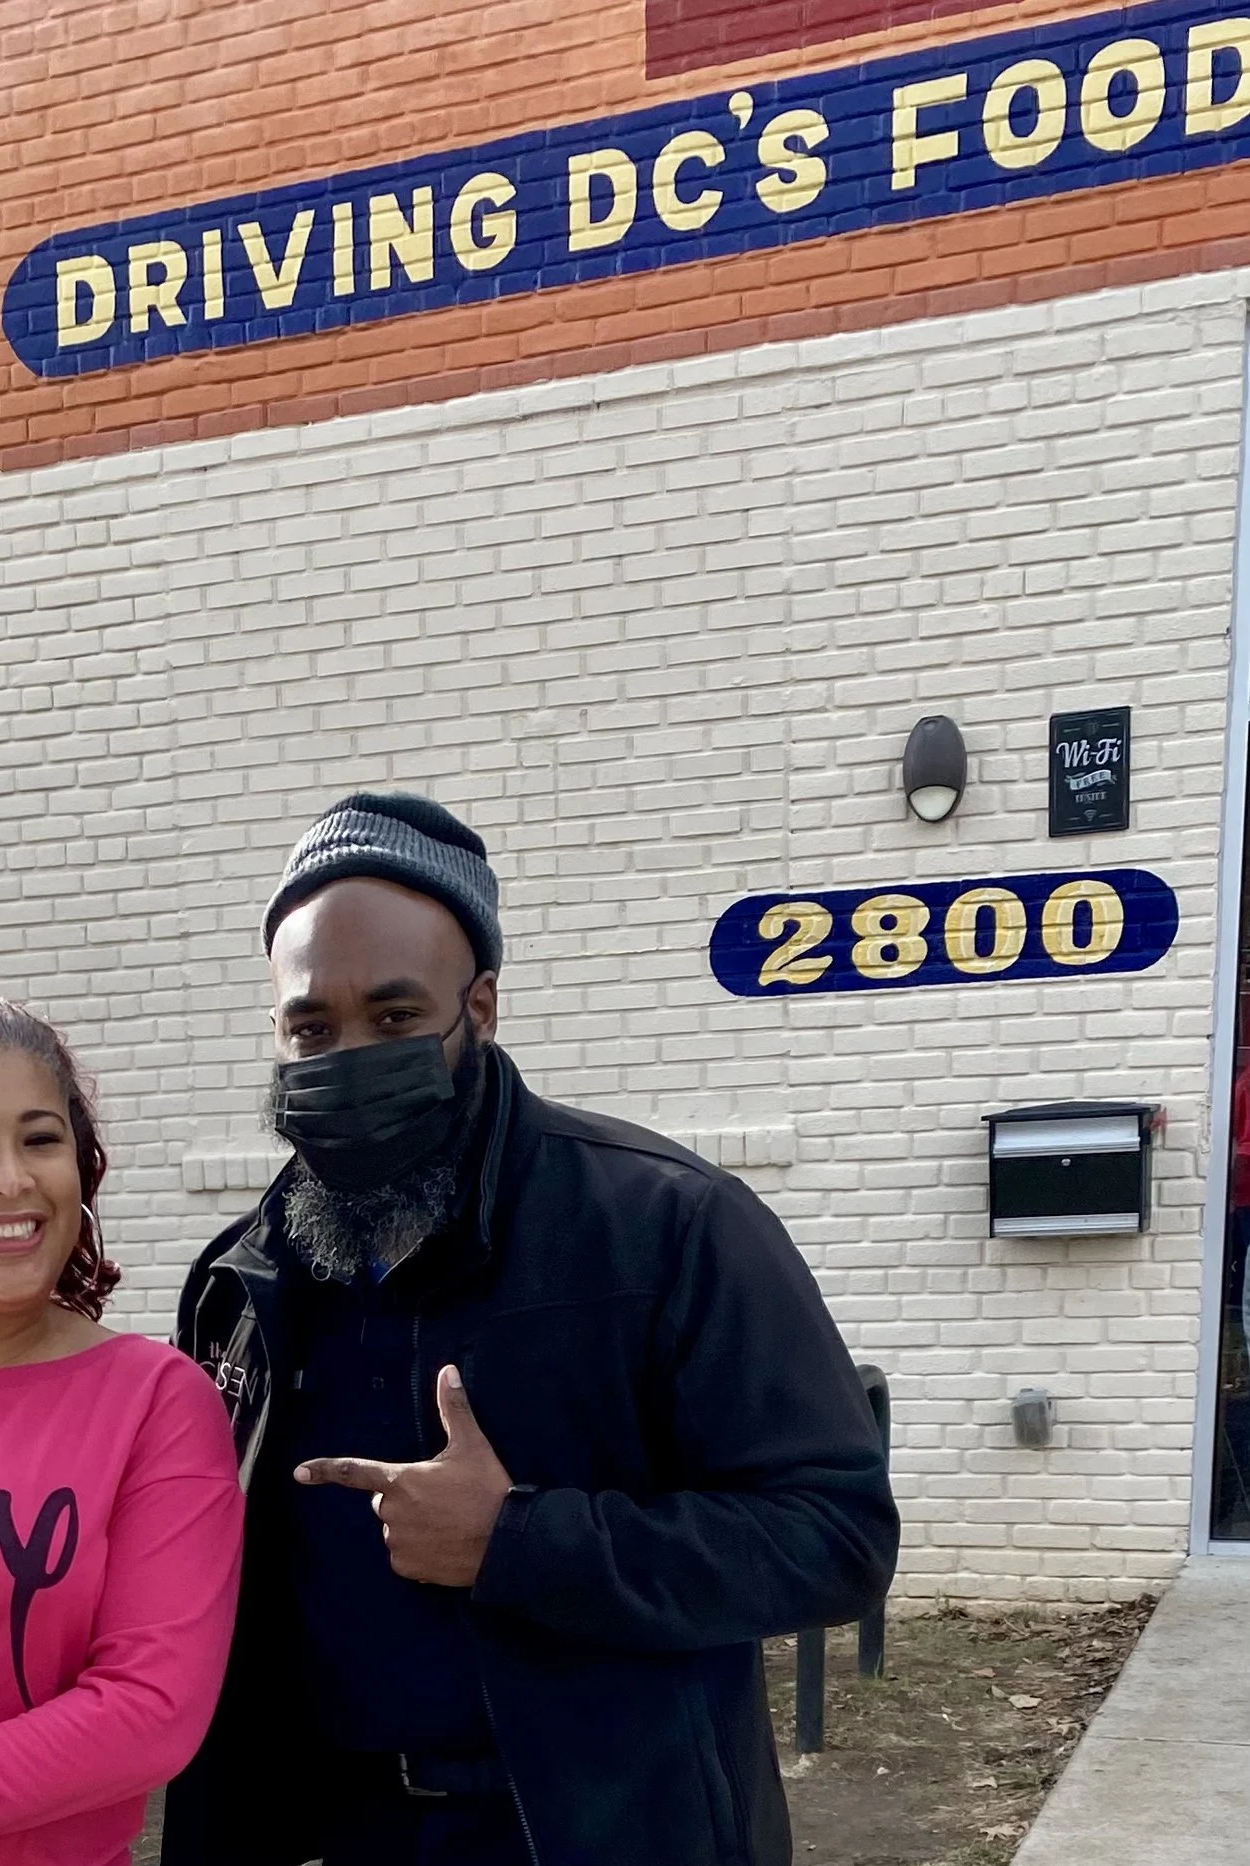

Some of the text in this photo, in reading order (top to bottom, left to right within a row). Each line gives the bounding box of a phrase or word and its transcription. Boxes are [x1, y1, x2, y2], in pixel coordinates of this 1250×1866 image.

[55, 16, 1250, 349] DRIVING DC'S FOOD
[1056, 738, 1122, 768] Wi-Fi
[1075, 772, 1108, 788] FREE
[757, 879, 1125, 987] 2800
